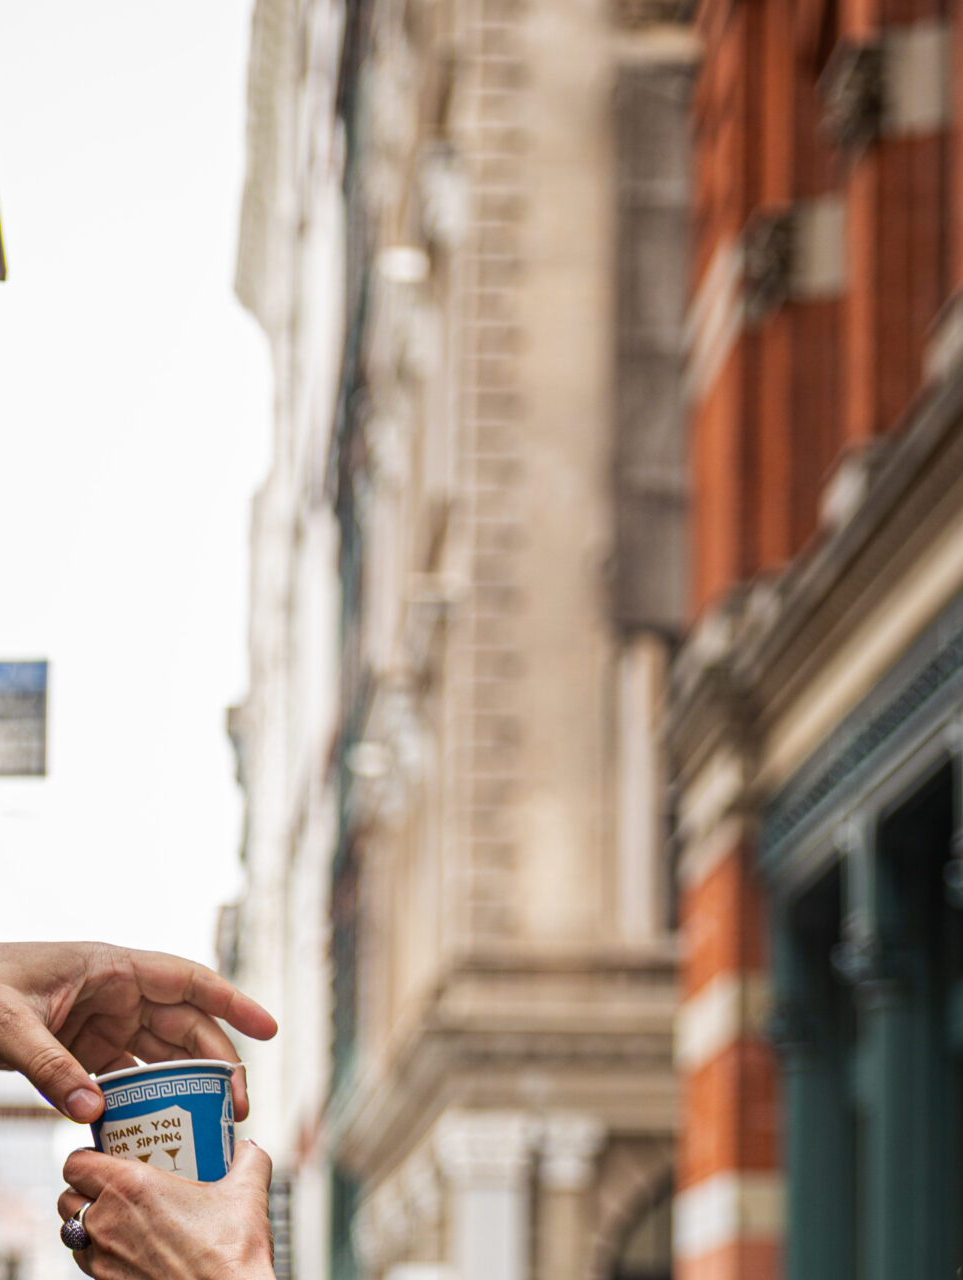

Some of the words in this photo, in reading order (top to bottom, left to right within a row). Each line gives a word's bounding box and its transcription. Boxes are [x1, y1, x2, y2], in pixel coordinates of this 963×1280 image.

[106, 1124, 143, 1143] THANK
[151, 1117, 181, 1131] YOU
[109, 1142, 130, 1156] FOR
[136, 1132, 182, 1149] SIPPING
